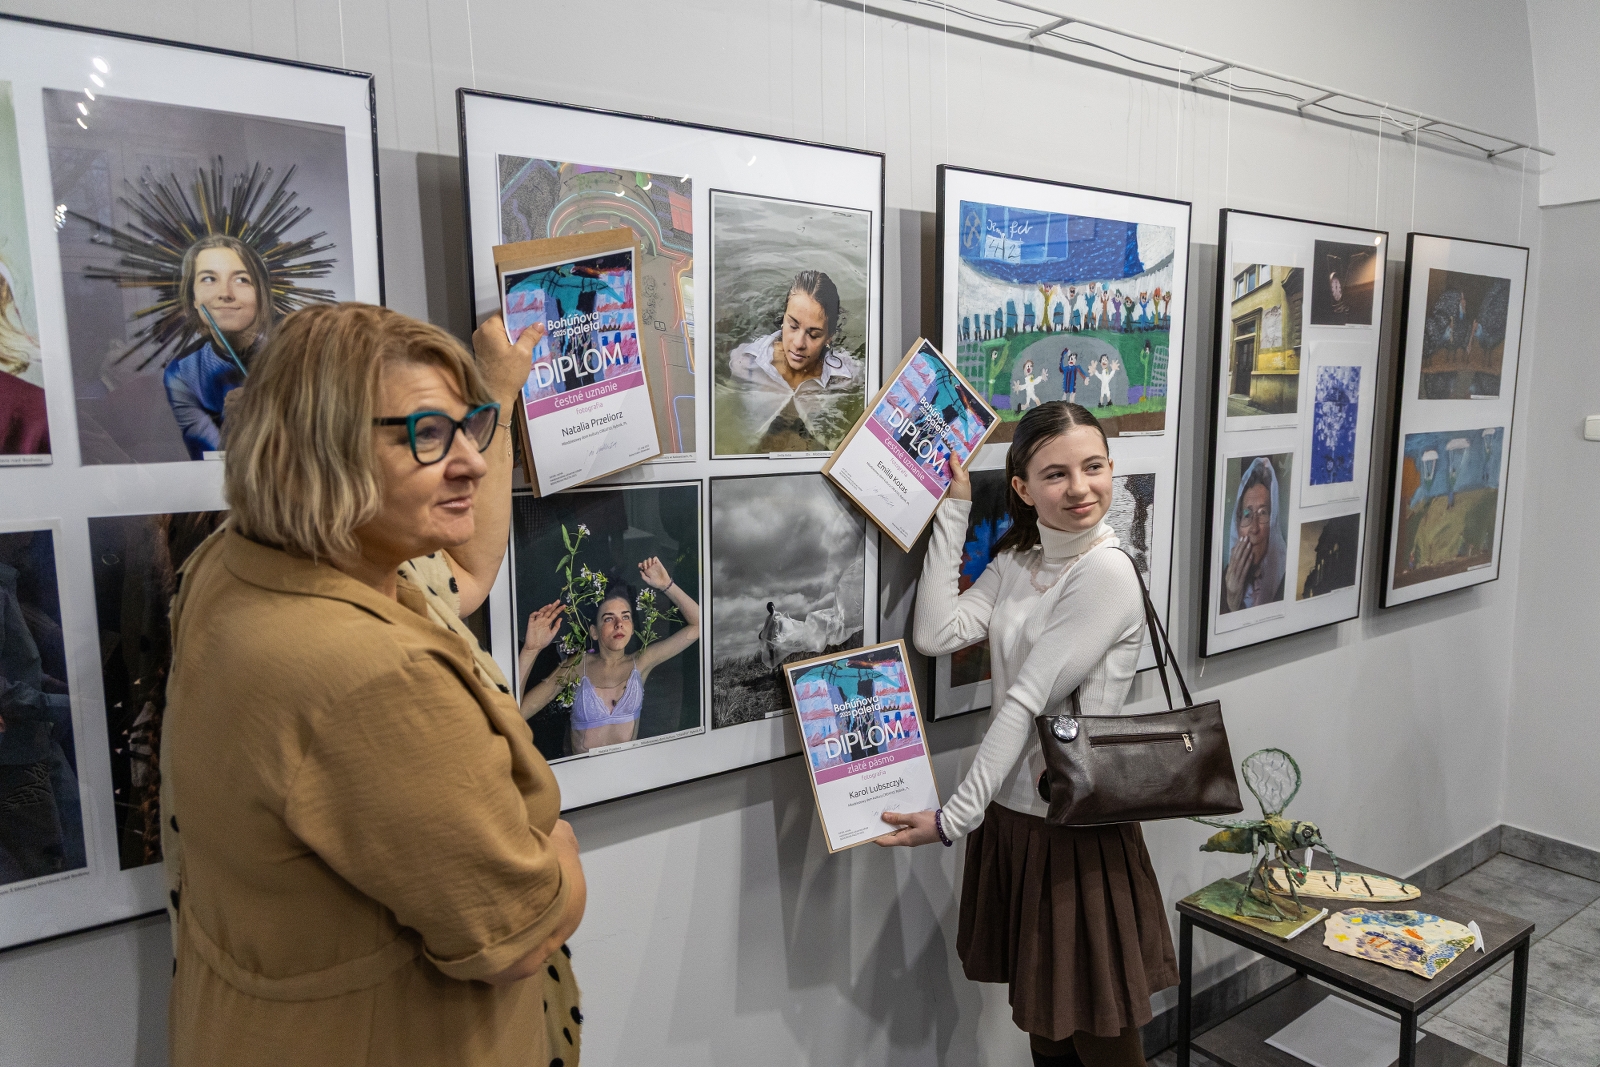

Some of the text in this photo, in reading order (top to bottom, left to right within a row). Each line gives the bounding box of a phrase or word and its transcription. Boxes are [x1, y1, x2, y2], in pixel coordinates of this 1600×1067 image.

[547, 311, 600, 331] Bohúňova
[567, 320, 600, 339] paleta
[534, 342, 625, 388] DIPLOM
[554, 382, 618, 408] čestné uznanie
[575, 402, 604, 415] fotografia
[920, 396, 951, 433] Bohúňova
[561, 421, 590, 437] Natalia
[590, 411, 624, 428] Przeliorz
[925, 414, 948, 438] paleta
[888, 407, 946, 474] DIPLOM
[884, 437, 904, 459] čestné
[903, 457, 925, 481] uznanie
[890, 457, 908, 478] fotografia
[876, 460, 894, 479] Emilia
[893, 476, 909, 494] Kotas
[833, 695, 879, 713] Bohúňova
[851, 703, 881, 719] paleta
[824, 719, 906, 759] DIPLOM
[847, 755, 895, 774] zlaté pásmo
[861, 769, 887, 781] fotografia
[849, 786, 869, 799] Karol
[869, 777, 905, 794] Lubszczyk
